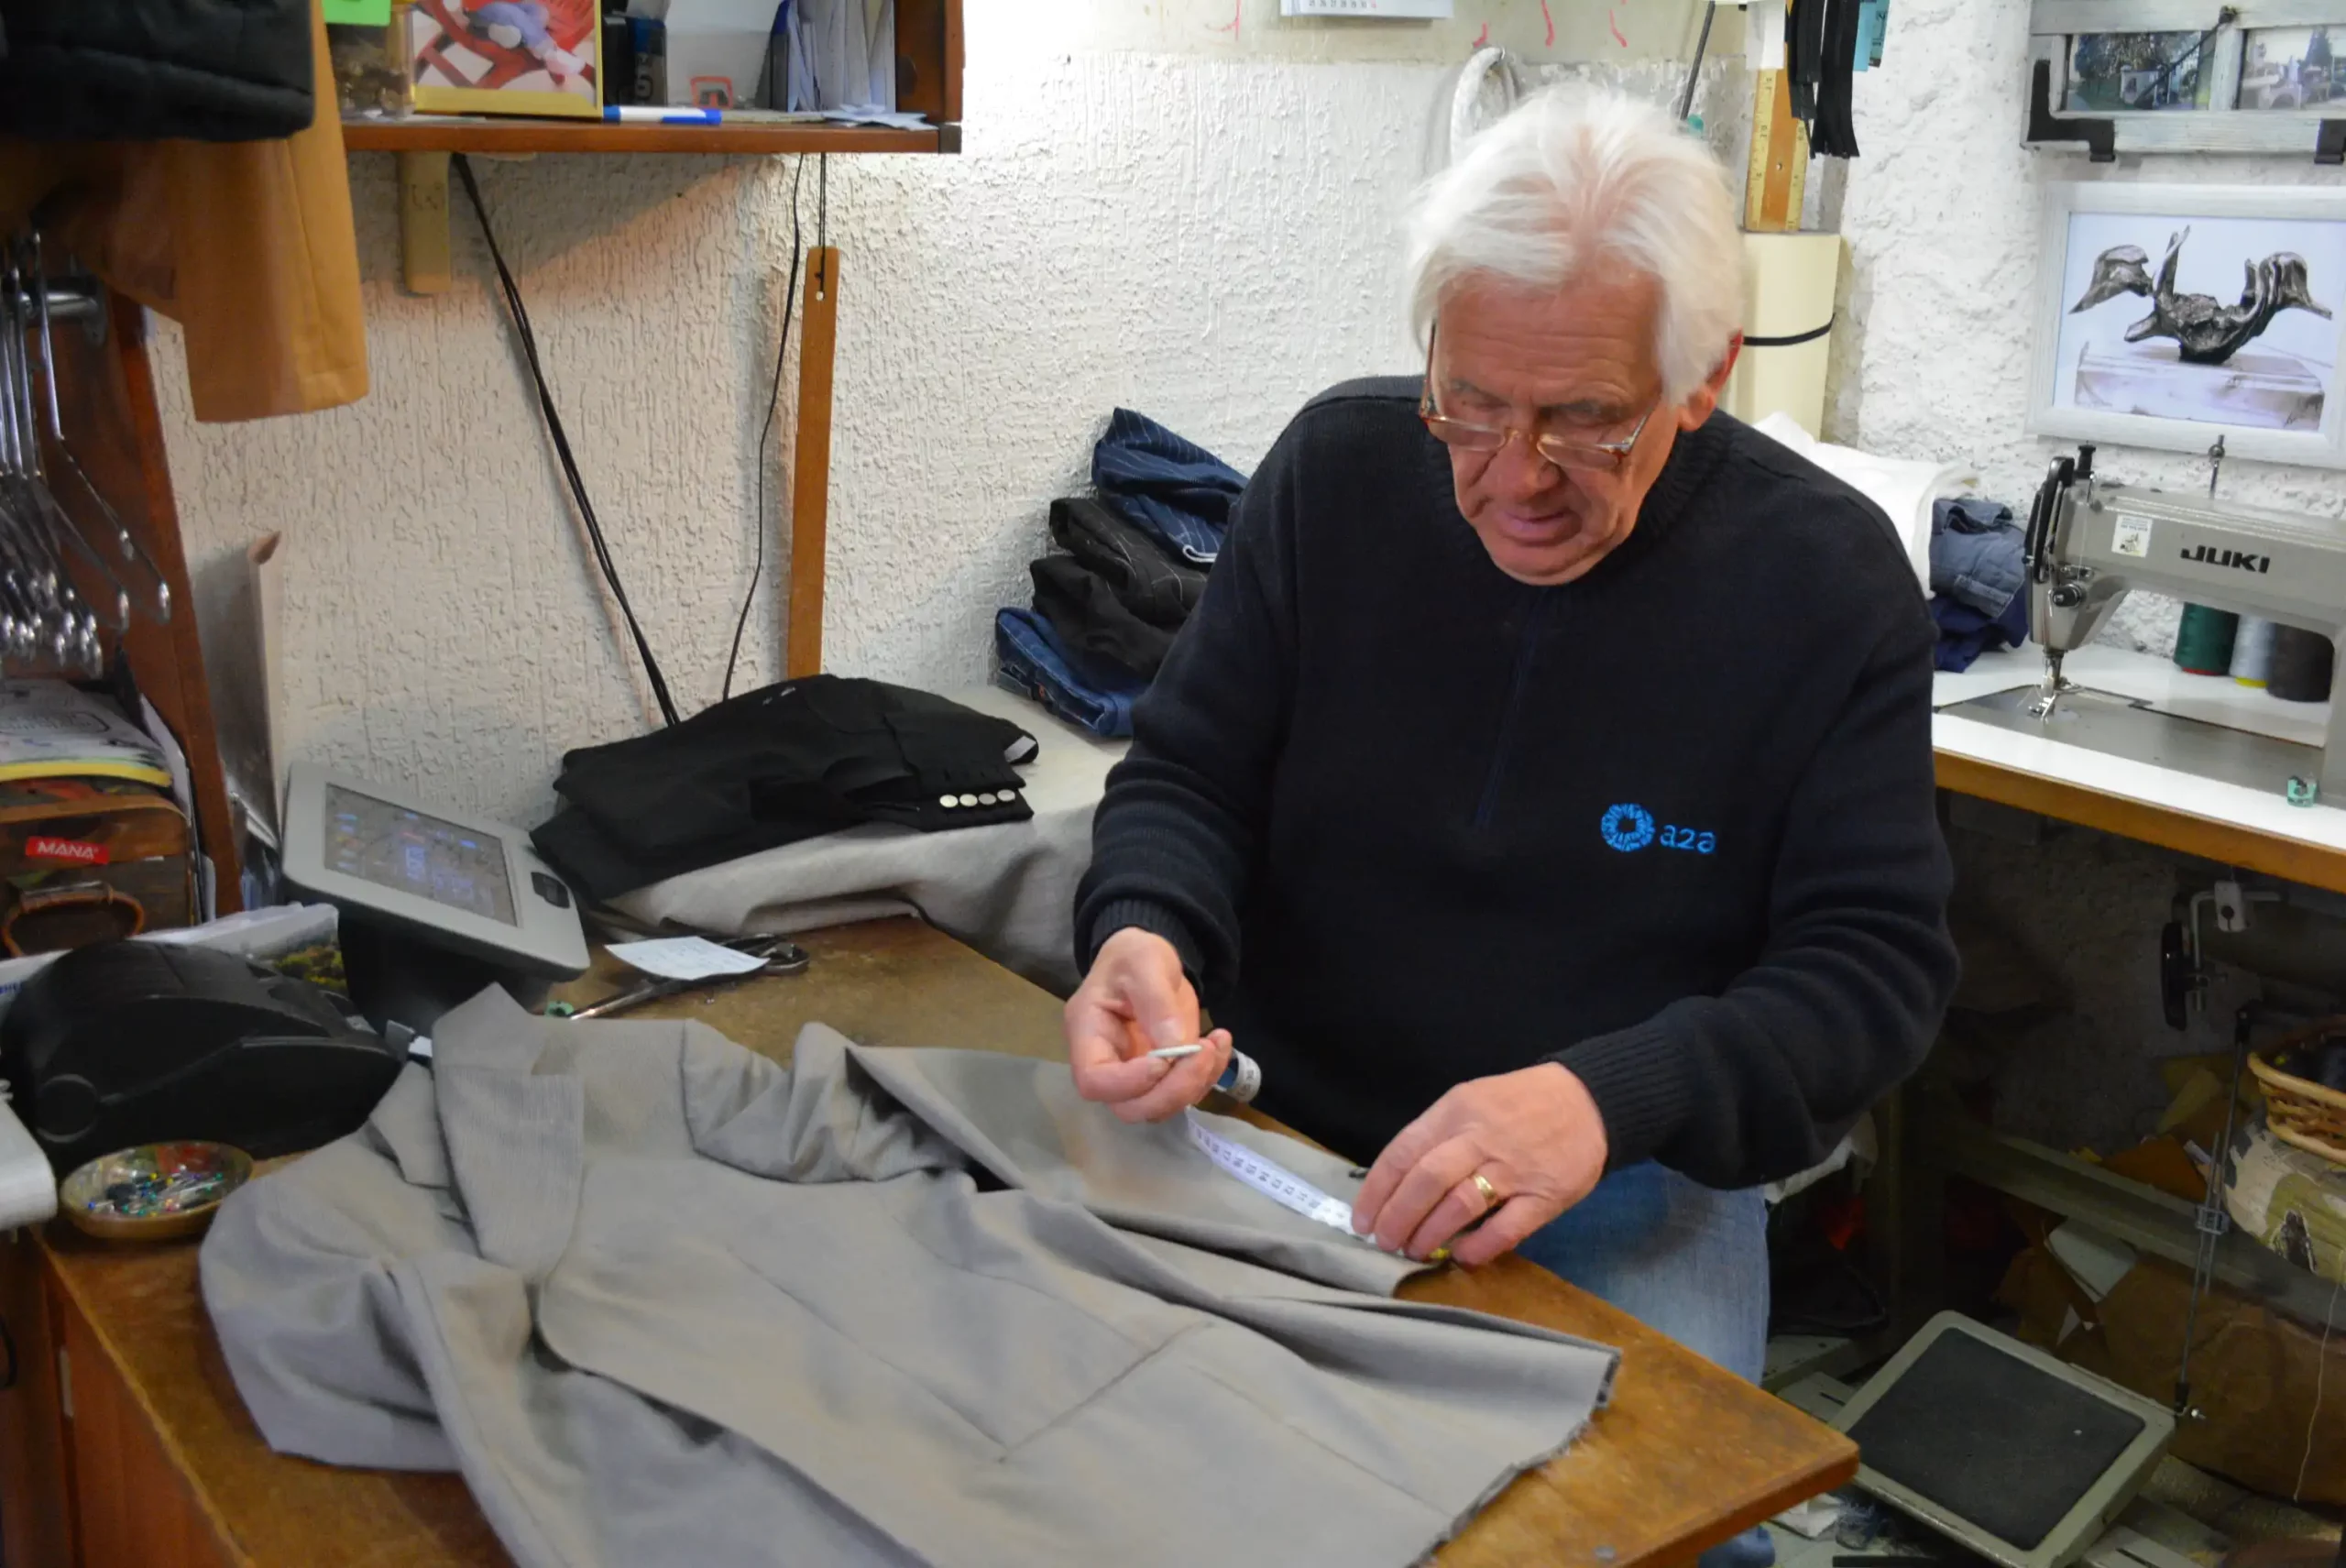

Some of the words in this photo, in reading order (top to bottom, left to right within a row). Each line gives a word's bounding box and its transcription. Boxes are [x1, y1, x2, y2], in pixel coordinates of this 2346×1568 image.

[2180, 545, 2271, 574] JUKI
[38, 841, 94, 860] MANA
[1660, 824, 1716, 853] a2a
